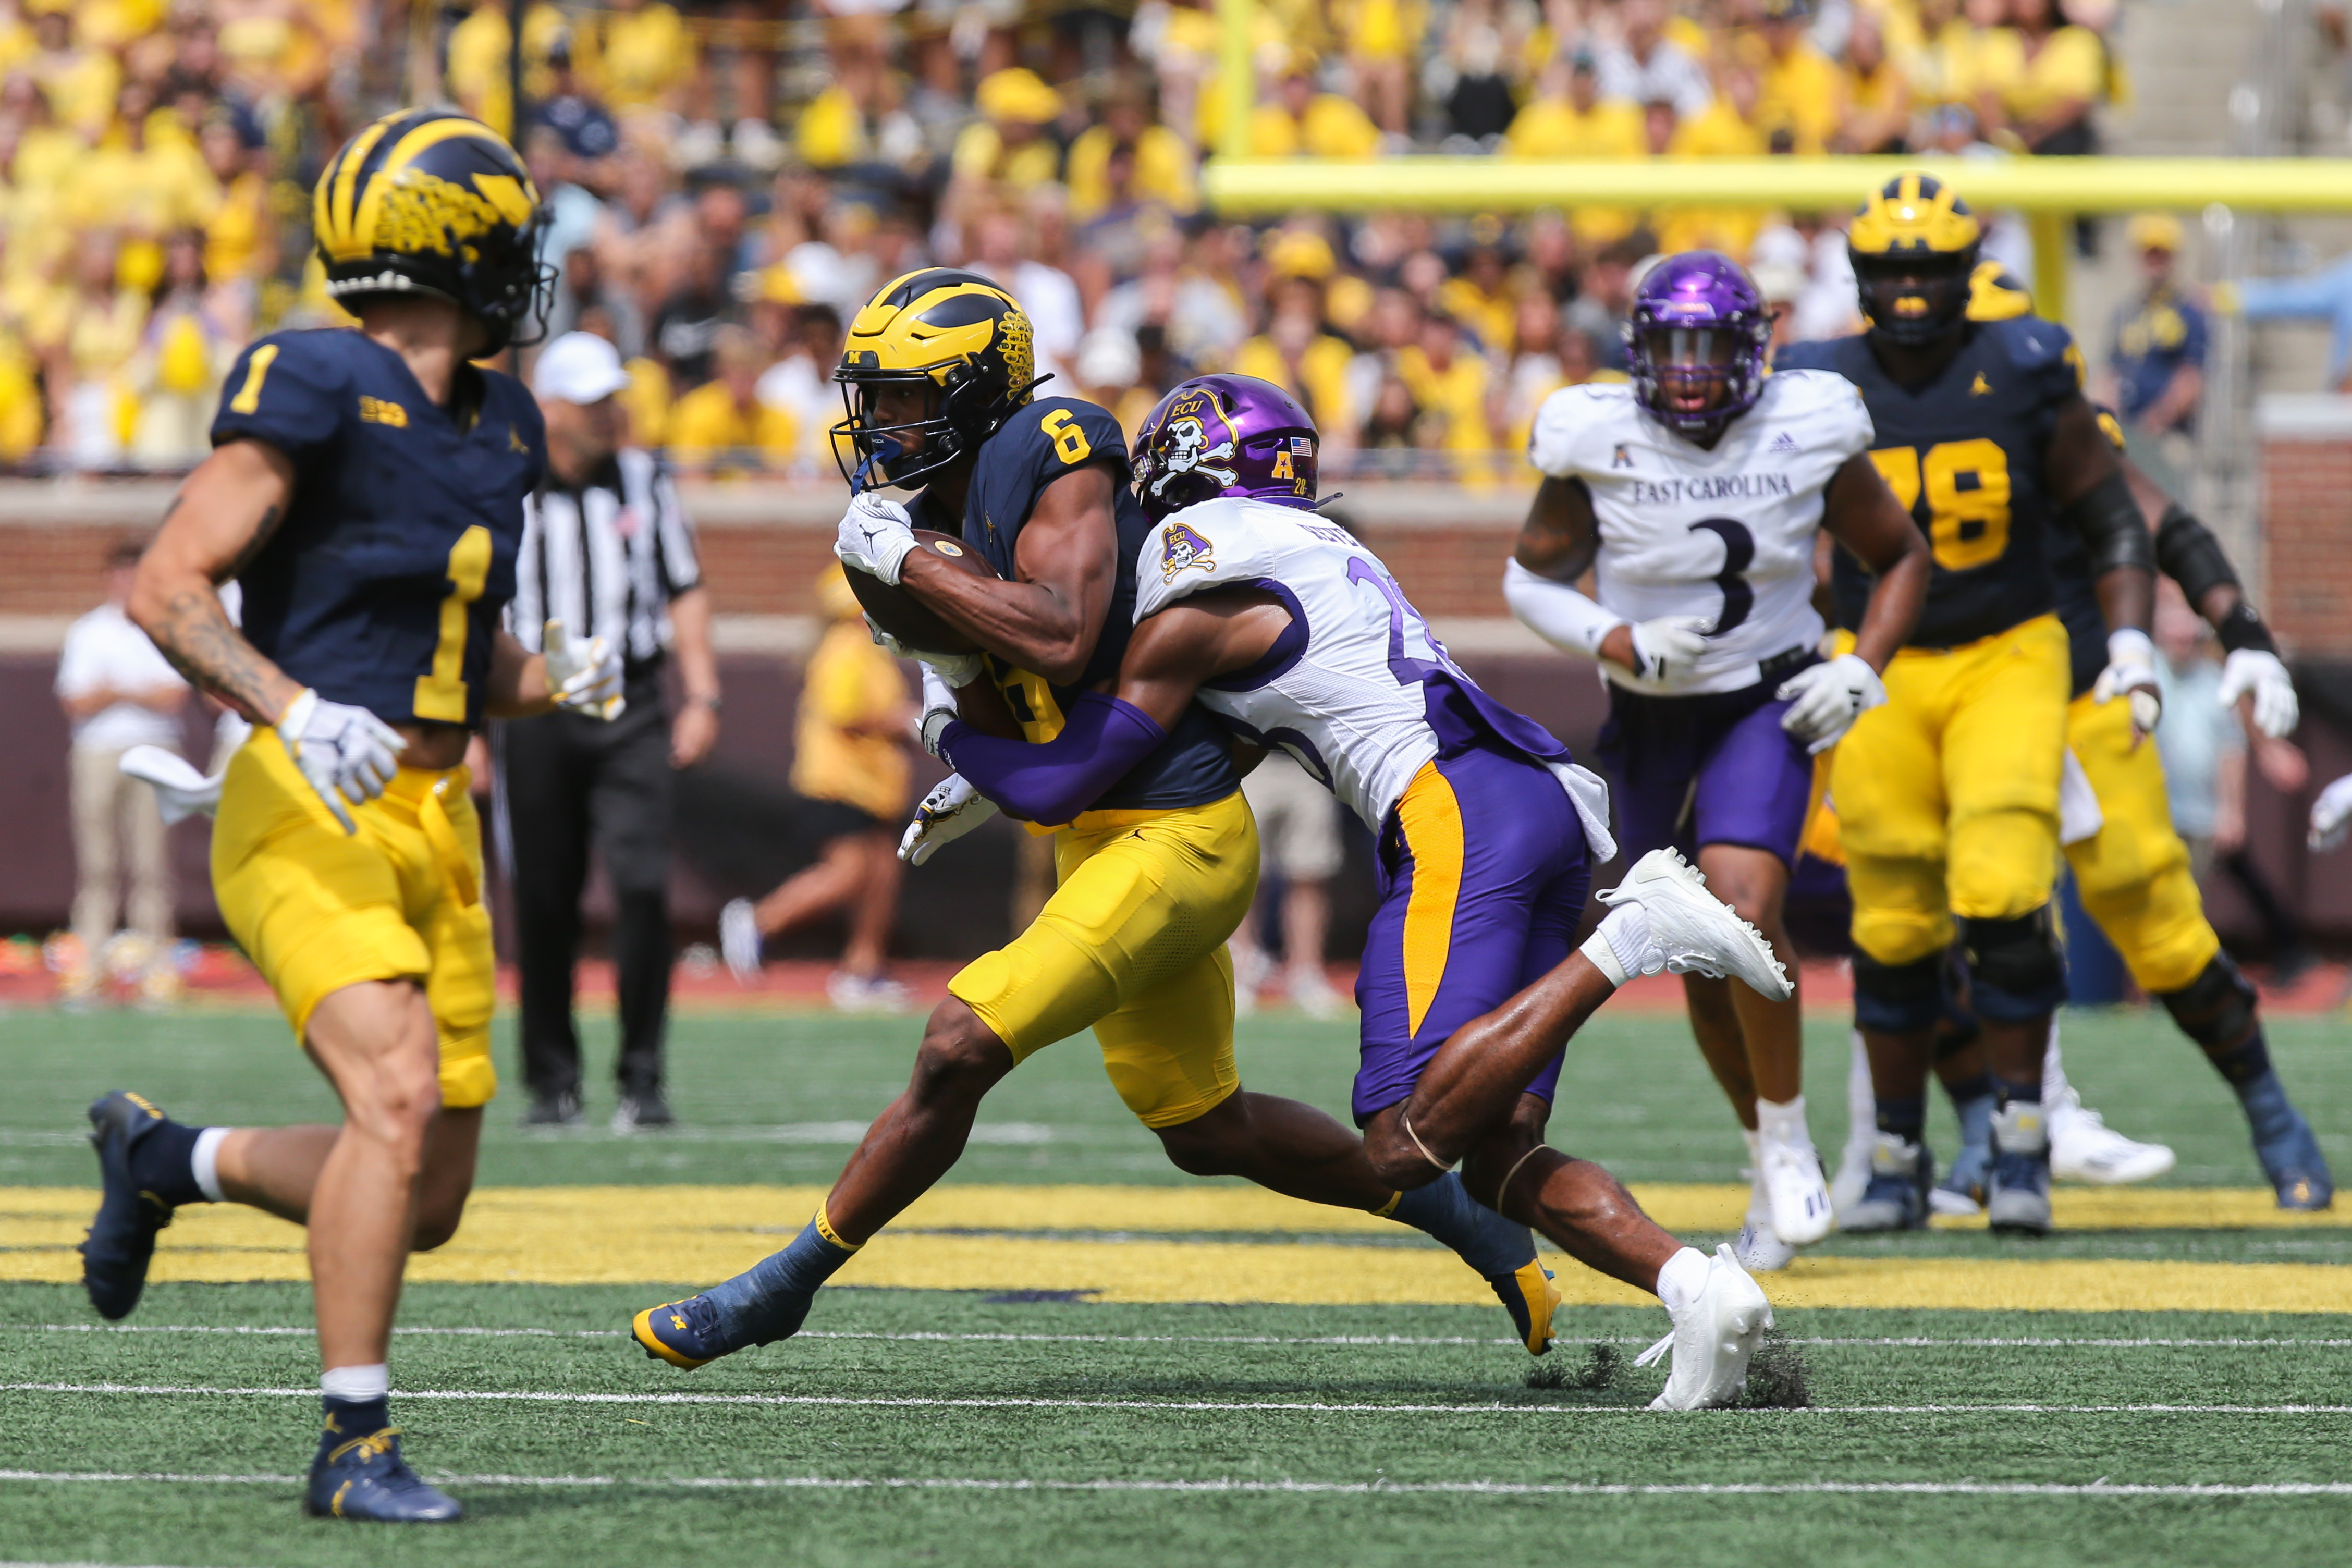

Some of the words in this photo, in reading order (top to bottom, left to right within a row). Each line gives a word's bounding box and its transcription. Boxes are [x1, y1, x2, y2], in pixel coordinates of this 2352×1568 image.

[848, 351, 861, 364] M
[230, 344, 280, 415] 1
[1170, 400, 1205, 418] ECU
[1041, 409, 1091, 465] 6
[1271, 451, 1294, 480] A
[1294, 477, 1306, 495] 28
[1634, 480, 1682, 503] EAST
[1688, 473, 1795, 500] CAROLINA
[1169, 530, 1185, 545] ECU
[1687, 518, 1756, 637] 3
[412, 524, 493, 724] 1
